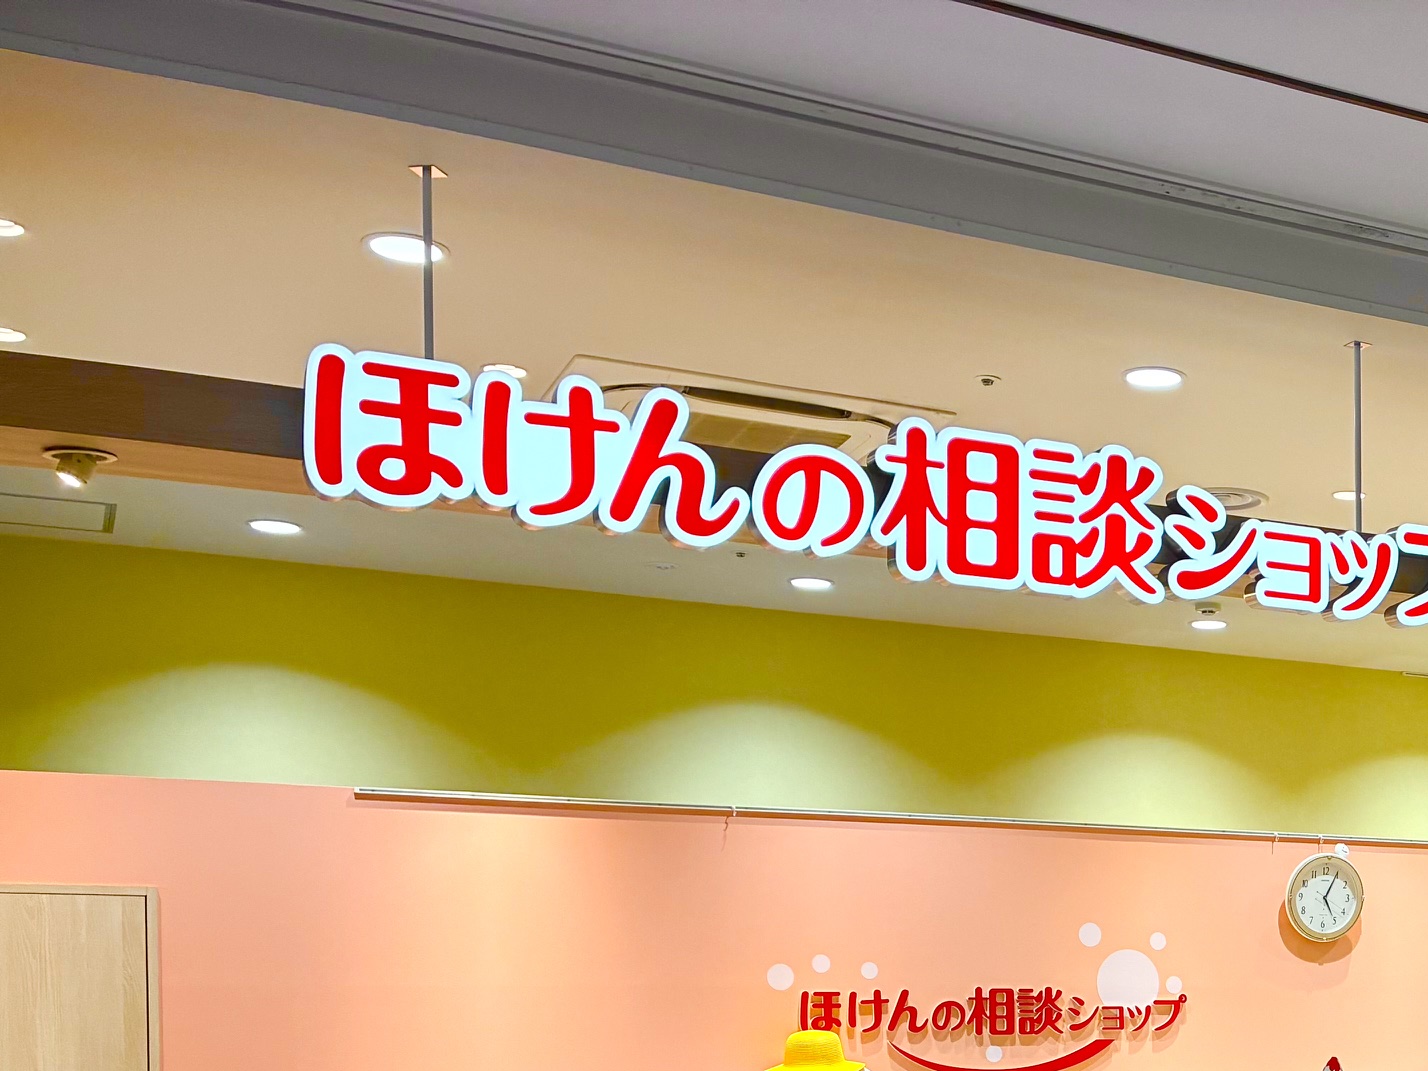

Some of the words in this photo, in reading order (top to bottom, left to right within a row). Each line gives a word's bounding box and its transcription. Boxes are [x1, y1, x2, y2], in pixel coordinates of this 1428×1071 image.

[1322, 866, 1330, 876] 12
[799, 986, 1187, 1036] ほけんの相談ショップ
